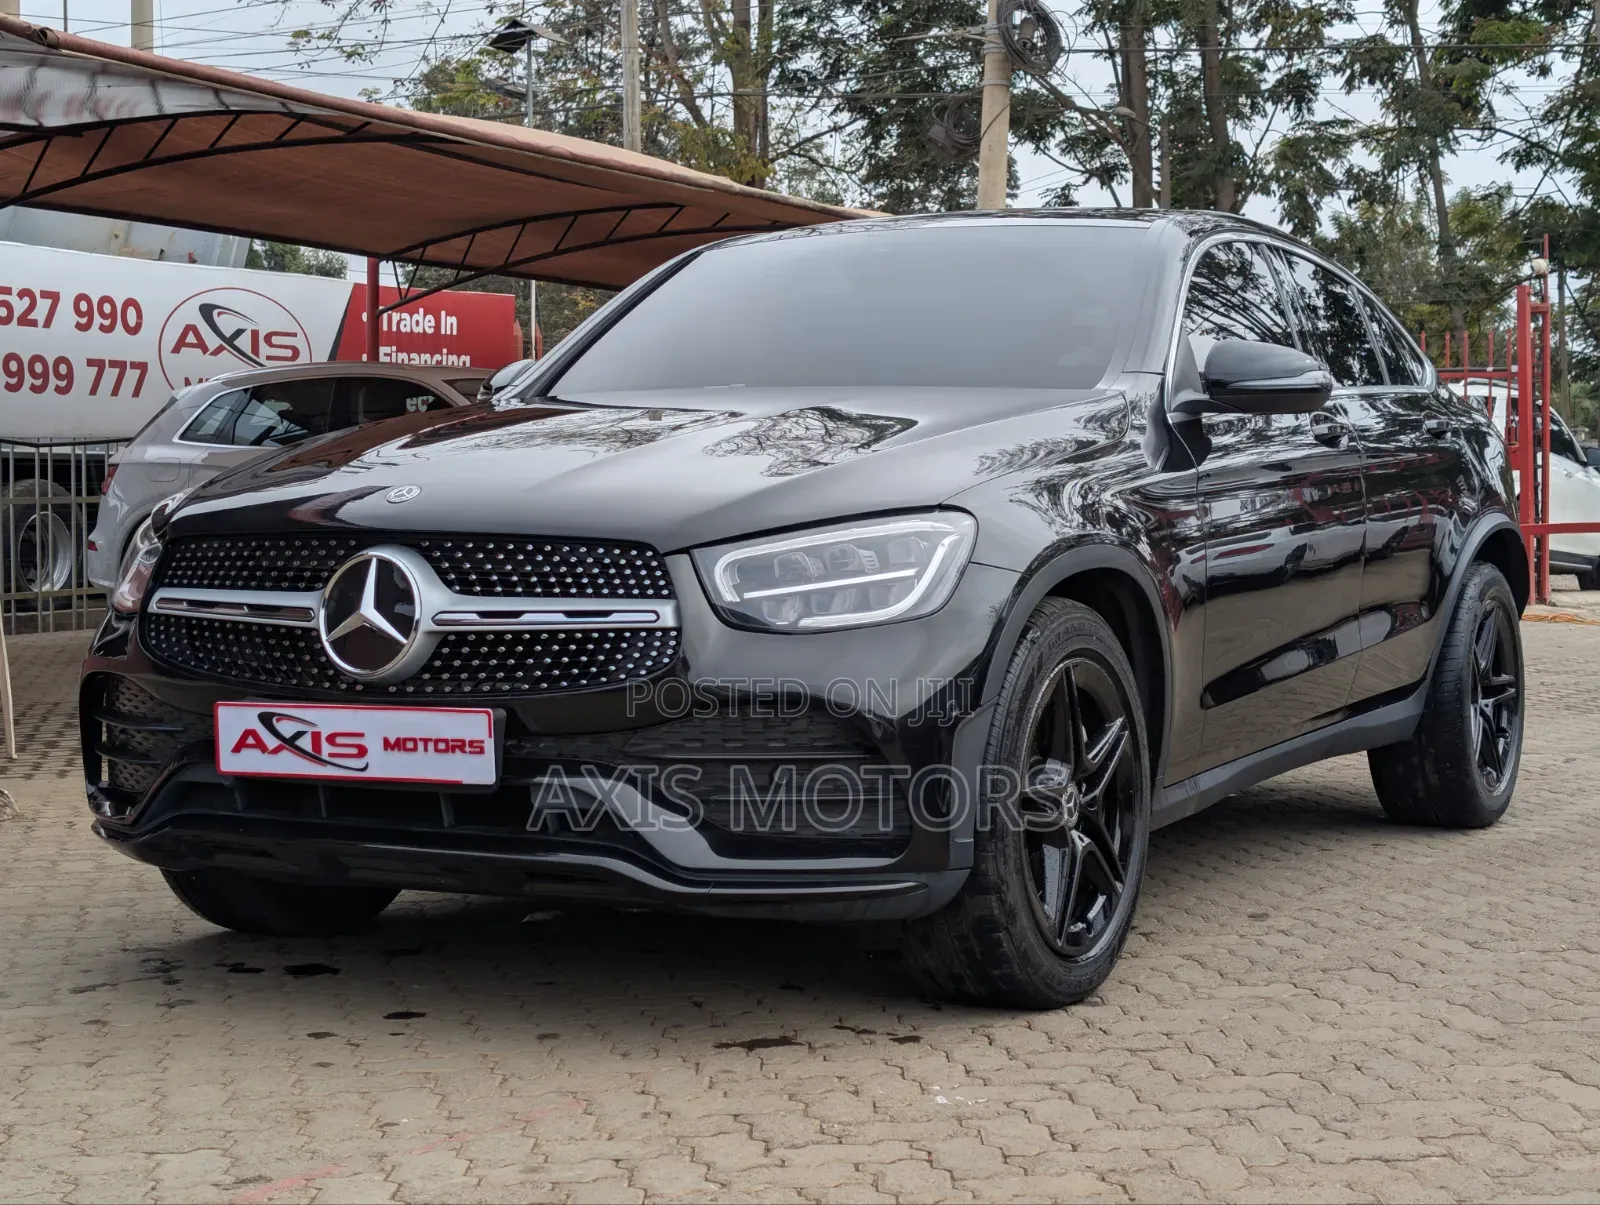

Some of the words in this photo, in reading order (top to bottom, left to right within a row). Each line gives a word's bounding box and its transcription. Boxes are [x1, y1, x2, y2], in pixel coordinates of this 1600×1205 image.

[0, 286, 60, 329] 527
[73, 292, 143, 336] 990
[171, 305, 300, 366] AXIS
[379, 306, 435, 333] Trade
[441, 310, 457, 335] In
[2, 352, 75, 395] 999
[86, 358, 148, 398] 777
[231, 713, 369, 770] AXIS
[383, 737, 485, 755] MOTORS
